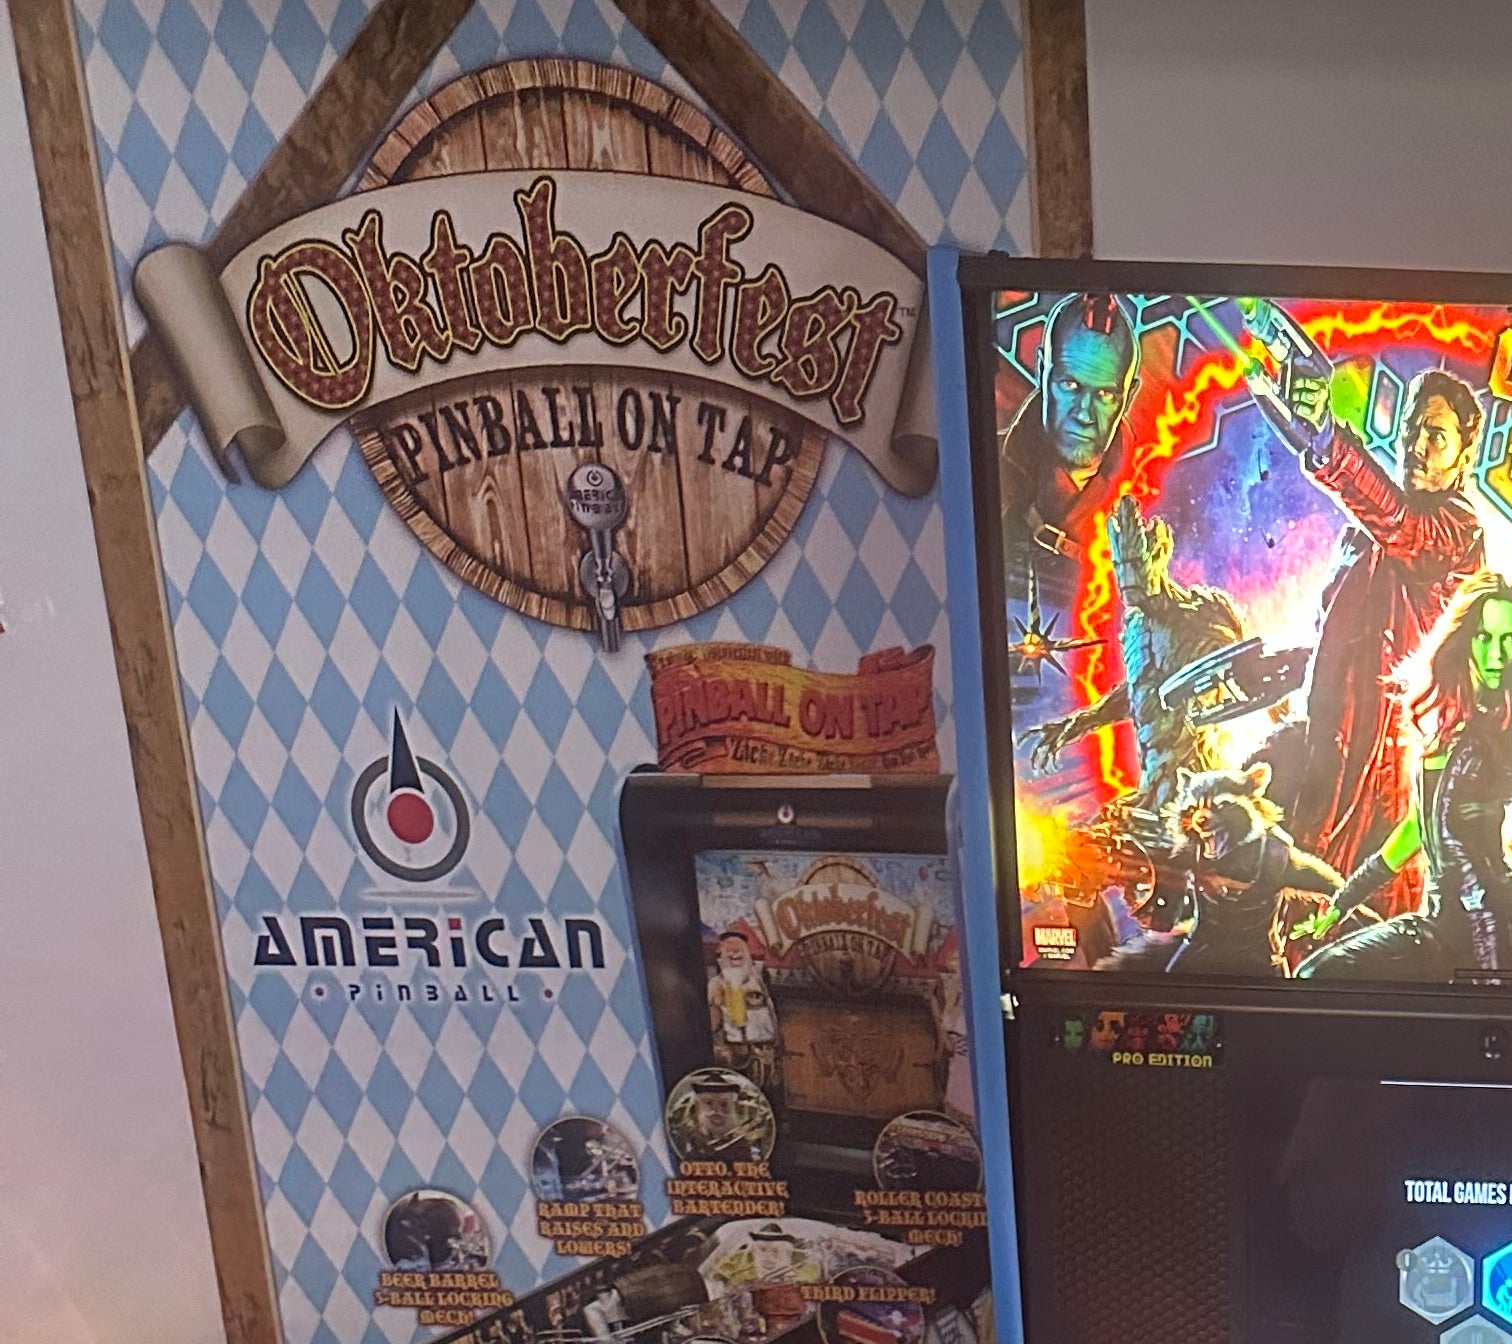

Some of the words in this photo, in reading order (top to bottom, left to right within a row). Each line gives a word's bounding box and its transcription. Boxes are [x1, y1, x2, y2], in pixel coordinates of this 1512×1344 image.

[247, 176, 902, 426] Oktoberfest
[391, 386, 603, 486] PINBALL
[617, 386, 682, 455] ON
[697, 402, 794, 487] TAP
[659, 681, 791, 743] PINBALL
[800, 690, 854, 740] ON
[1034, 927, 1078, 946] MARVEL
[1112, 1052, 1144, 1065] PRO
[1149, 1052, 1213, 1068] EDITION
[734, 1162, 771, 1179] THE
[666, 1180, 789, 1198] INTERACTIVE
[1405, 1179, 1452, 1204] TOTAL
[1454, 1181, 1507, 1205] GAMES
[671, 1199, 786, 1217] BARTENDER!
[855, 1191, 921, 1208] ROLLER
[924, 1192, 986, 1208] COAST
[538, 1203, 589, 1221] RAMP
[592, 1203, 643, 1220] THAT
[537, 1220, 602, 1238] RAISES
[605, 1221, 644, 1238] AND
[557, 1239, 633, 1257] LOWERS!
[381, 1273, 425, 1290] BEER
[428, 1274, 499, 1291] BARREL
[434, 1291, 514, 1308] LOCKING
[801, 1285, 859, 1302] THIRD
[863, 1287, 936, 1304] FLIPPER!
[419, 1308, 475, 1327] MECH!
